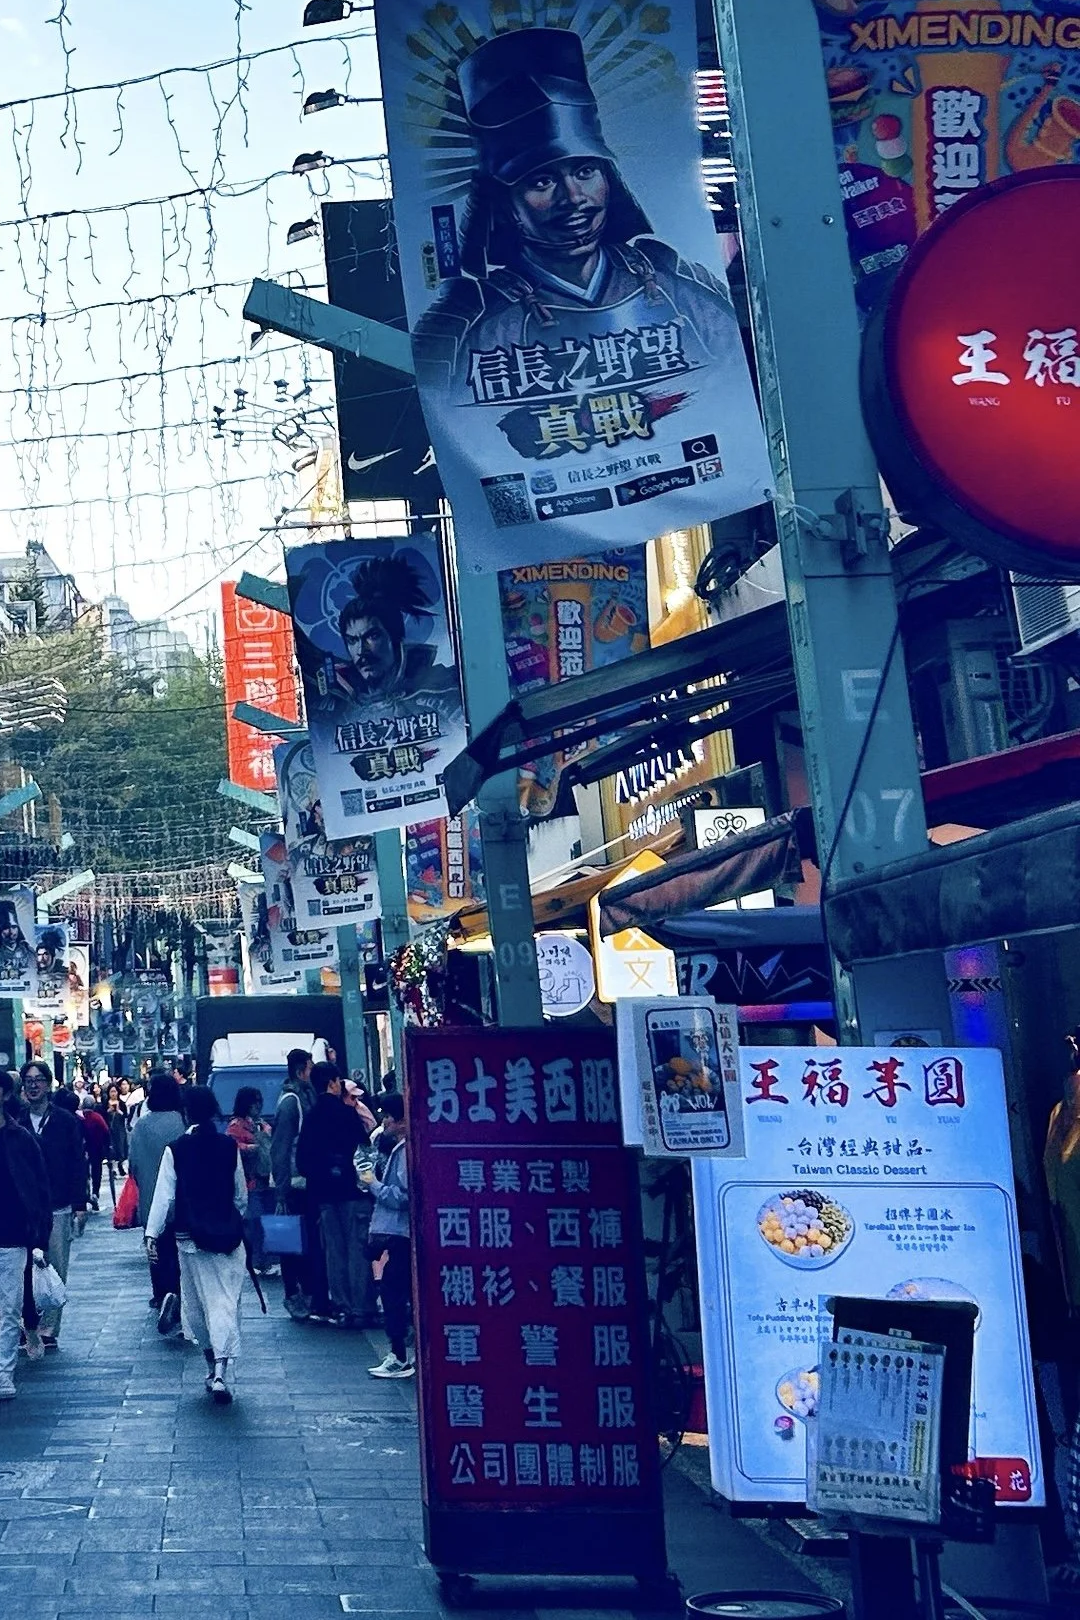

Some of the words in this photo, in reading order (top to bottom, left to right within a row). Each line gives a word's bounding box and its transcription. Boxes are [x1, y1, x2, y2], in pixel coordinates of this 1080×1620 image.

[850, 12, 1080, 53] XIMENDING
[471, 324, 693, 401] 信長之野望
[952, 328, 1080, 388] 王福
[530, 392, 650, 455] 真戰
[512, 563, 630, 583] XIMENDING
[556, 600, 585, 682] 歡迎蒞
[841, 669, 884, 721] E
[336, 712, 441, 751] 信長之野望
[845, 788, 914, 843] 07
[500, 883, 524, 910] E
[500, 942, 534, 967] 09
[426, 1056, 618, 1125] 男士美西服
[745, 1056, 966, 1109] 王福芋圓
[457, 1160, 590, 1195] 專業定製
[792, 1163, 833, 1175] Taiwan
[836, 1164, 880, 1175] Classic
[883, 1164, 928, 1175] Dessert
